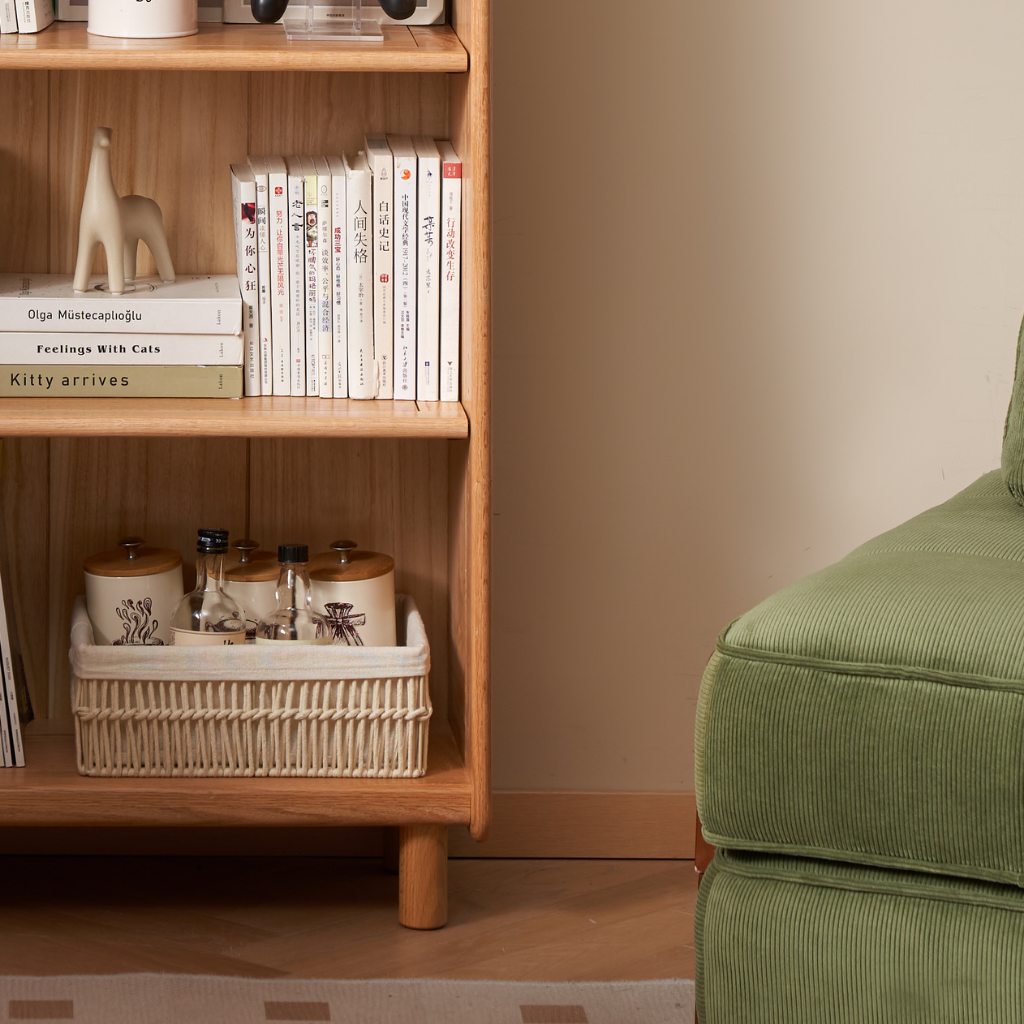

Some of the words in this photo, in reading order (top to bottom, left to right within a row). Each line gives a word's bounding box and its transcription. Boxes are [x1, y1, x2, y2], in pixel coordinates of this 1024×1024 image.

[353, 200, 368, 264] 人间失格
[379, 201, 390, 252] 白话史记
[401, 194, 409, 246] 中国现代文学经典
[245, 227, 257, 292] 为你心狂
[28, 309, 53, 322] Olga
[37, 344, 92, 355] Feelings
[97, 344, 127, 354] With
[132, 344, 161, 354] Cats
[10, 373, 54, 389] Kitty
[62, 373, 129, 386] arrives
